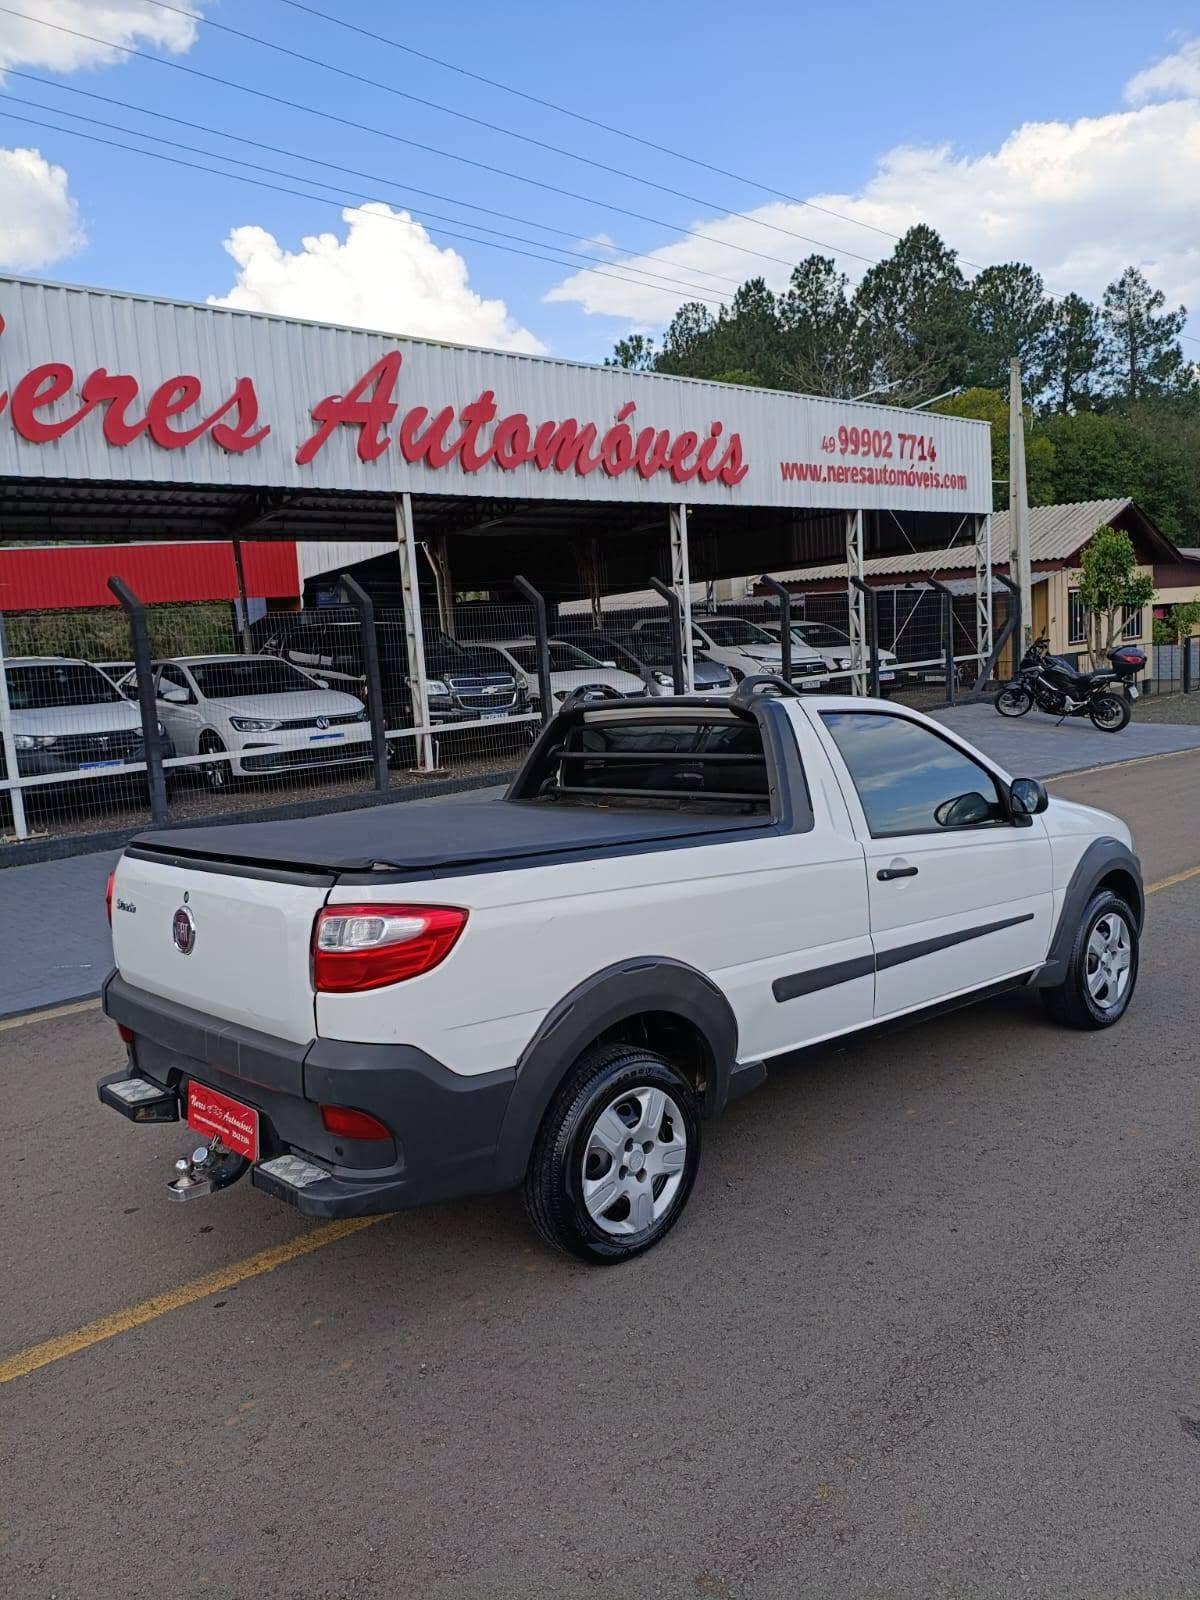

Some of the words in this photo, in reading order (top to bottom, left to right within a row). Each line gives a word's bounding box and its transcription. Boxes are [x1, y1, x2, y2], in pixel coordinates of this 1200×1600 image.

[0, 312, 271, 453] eres
[295, 350, 749, 486] Automóveis
[821, 435, 836, 453] 49
[837, 425, 893, 458] 99902
[897, 433, 937, 462] 7714
[780, 461, 968, 490] www.neresautomóveis.com
